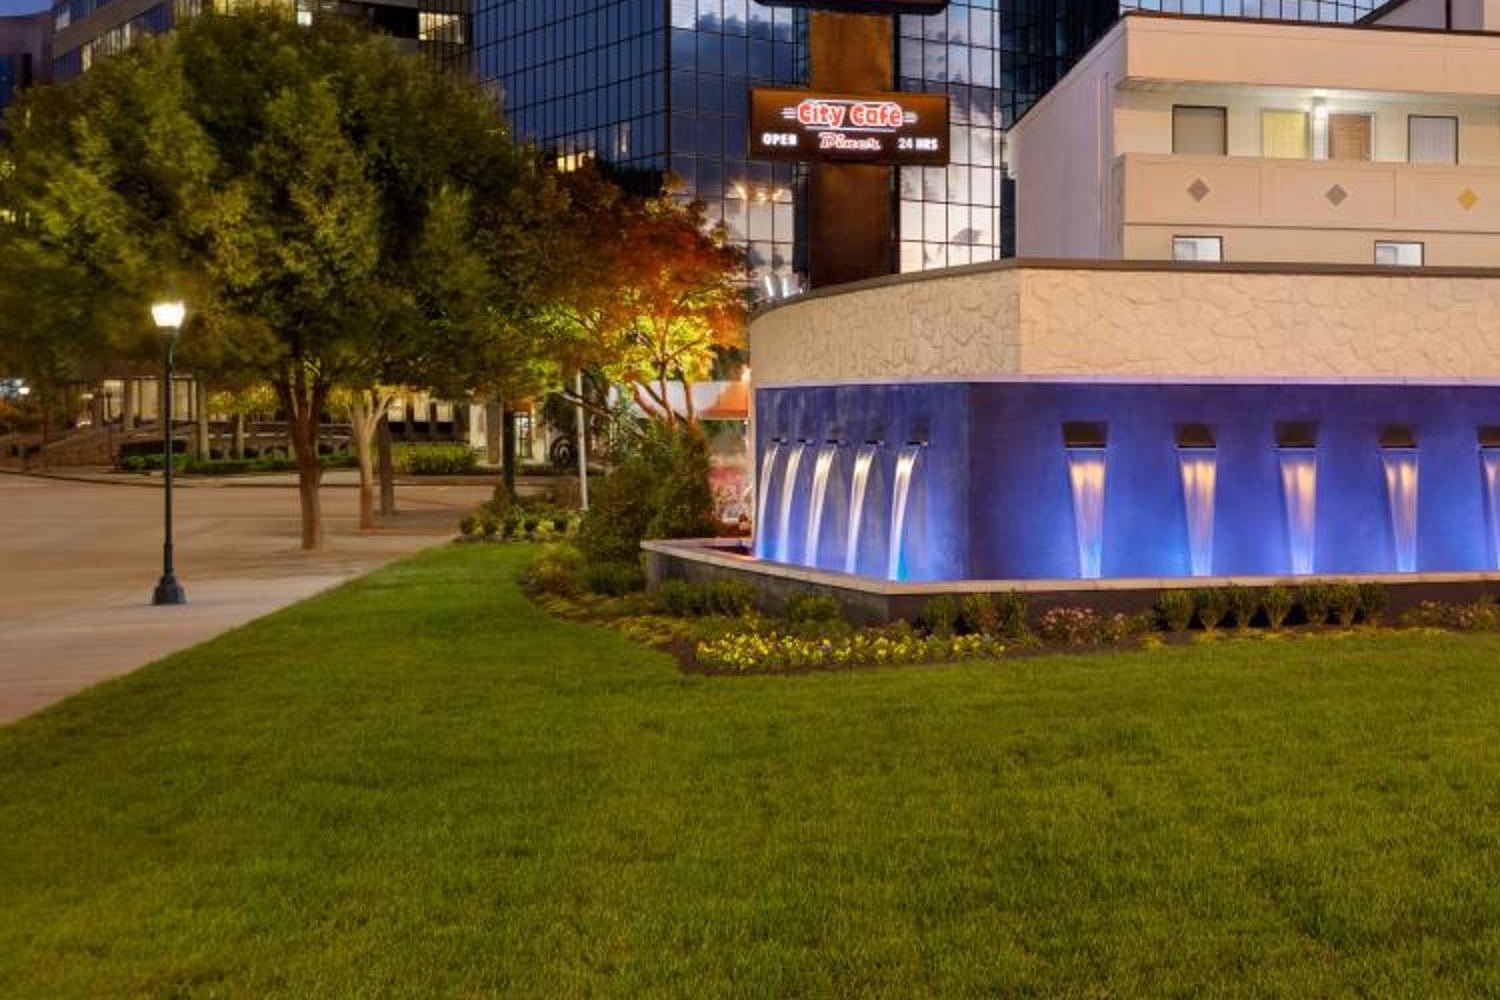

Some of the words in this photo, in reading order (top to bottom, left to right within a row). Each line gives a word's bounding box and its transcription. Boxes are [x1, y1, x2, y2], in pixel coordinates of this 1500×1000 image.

[798, 103, 846, 127] City
[762, 133, 798, 147] OPEN
[898, 137, 912, 149] 24
[916, 137, 939, 151] HRS
